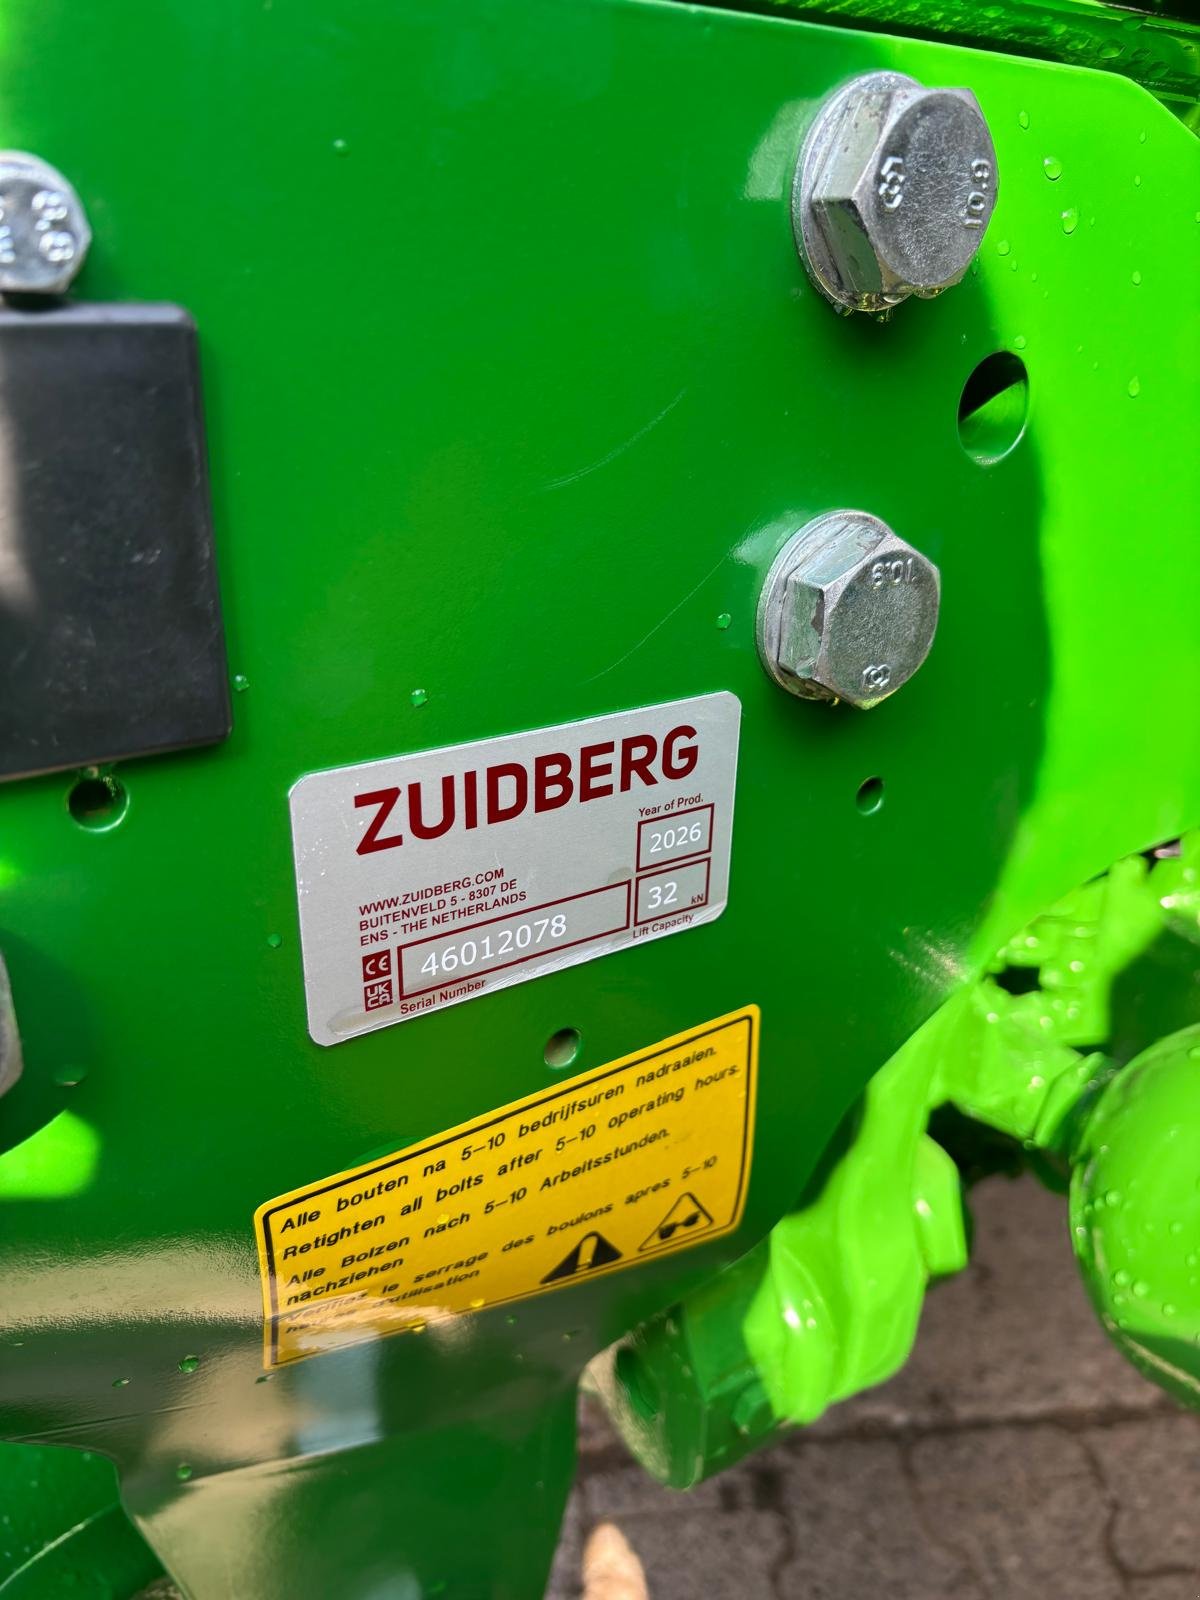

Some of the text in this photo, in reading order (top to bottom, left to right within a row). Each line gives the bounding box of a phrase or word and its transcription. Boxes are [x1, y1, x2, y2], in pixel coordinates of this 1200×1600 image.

[354, 725, 699, 856] ZUIDBERG
[638, 793, 704, 817] Year of Prod.
[650, 822, 702, 853] 2026
[359, 867, 505, 916] WWW.ZUIDBERG.COM
[359, 899, 446, 931] BUITENVELD
[450, 895, 458, 906] 5
[468, 884, 497, 901] 8307
[500, 878, 518, 890] DE
[648, 881, 704, 909] 32 kN
[360, 929, 389, 946] ENS
[401, 918, 428, 934] THE
[431, 891, 527, 926] NETHERLANDS
[632, 913, 695, 939] Lift Capacity
[365, 955, 389, 975] CE
[421, 914, 567, 977] 46012078
[400, 979, 487, 1015] Serial Number
[280, 1045, 717, 1233] Alle bouten na 5-10 bedrijfsuren nadraaien.
[282, 1063, 740, 1261] Retighten all bolts after 5-10 operating hours.
[285, 1128, 671, 1288] Alle Bolzen nach 5-10 Arbeitsstunden.
[382, 1283, 400, 1295] le
[413, 1252, 489, 1284] serrage
[502, 1233, 535, 1252] des
[547, 1202, 614, 1236] boulons
[625, 1177, 671, 1206] apres
[287, 1257, 404, 1305] nachziehen
